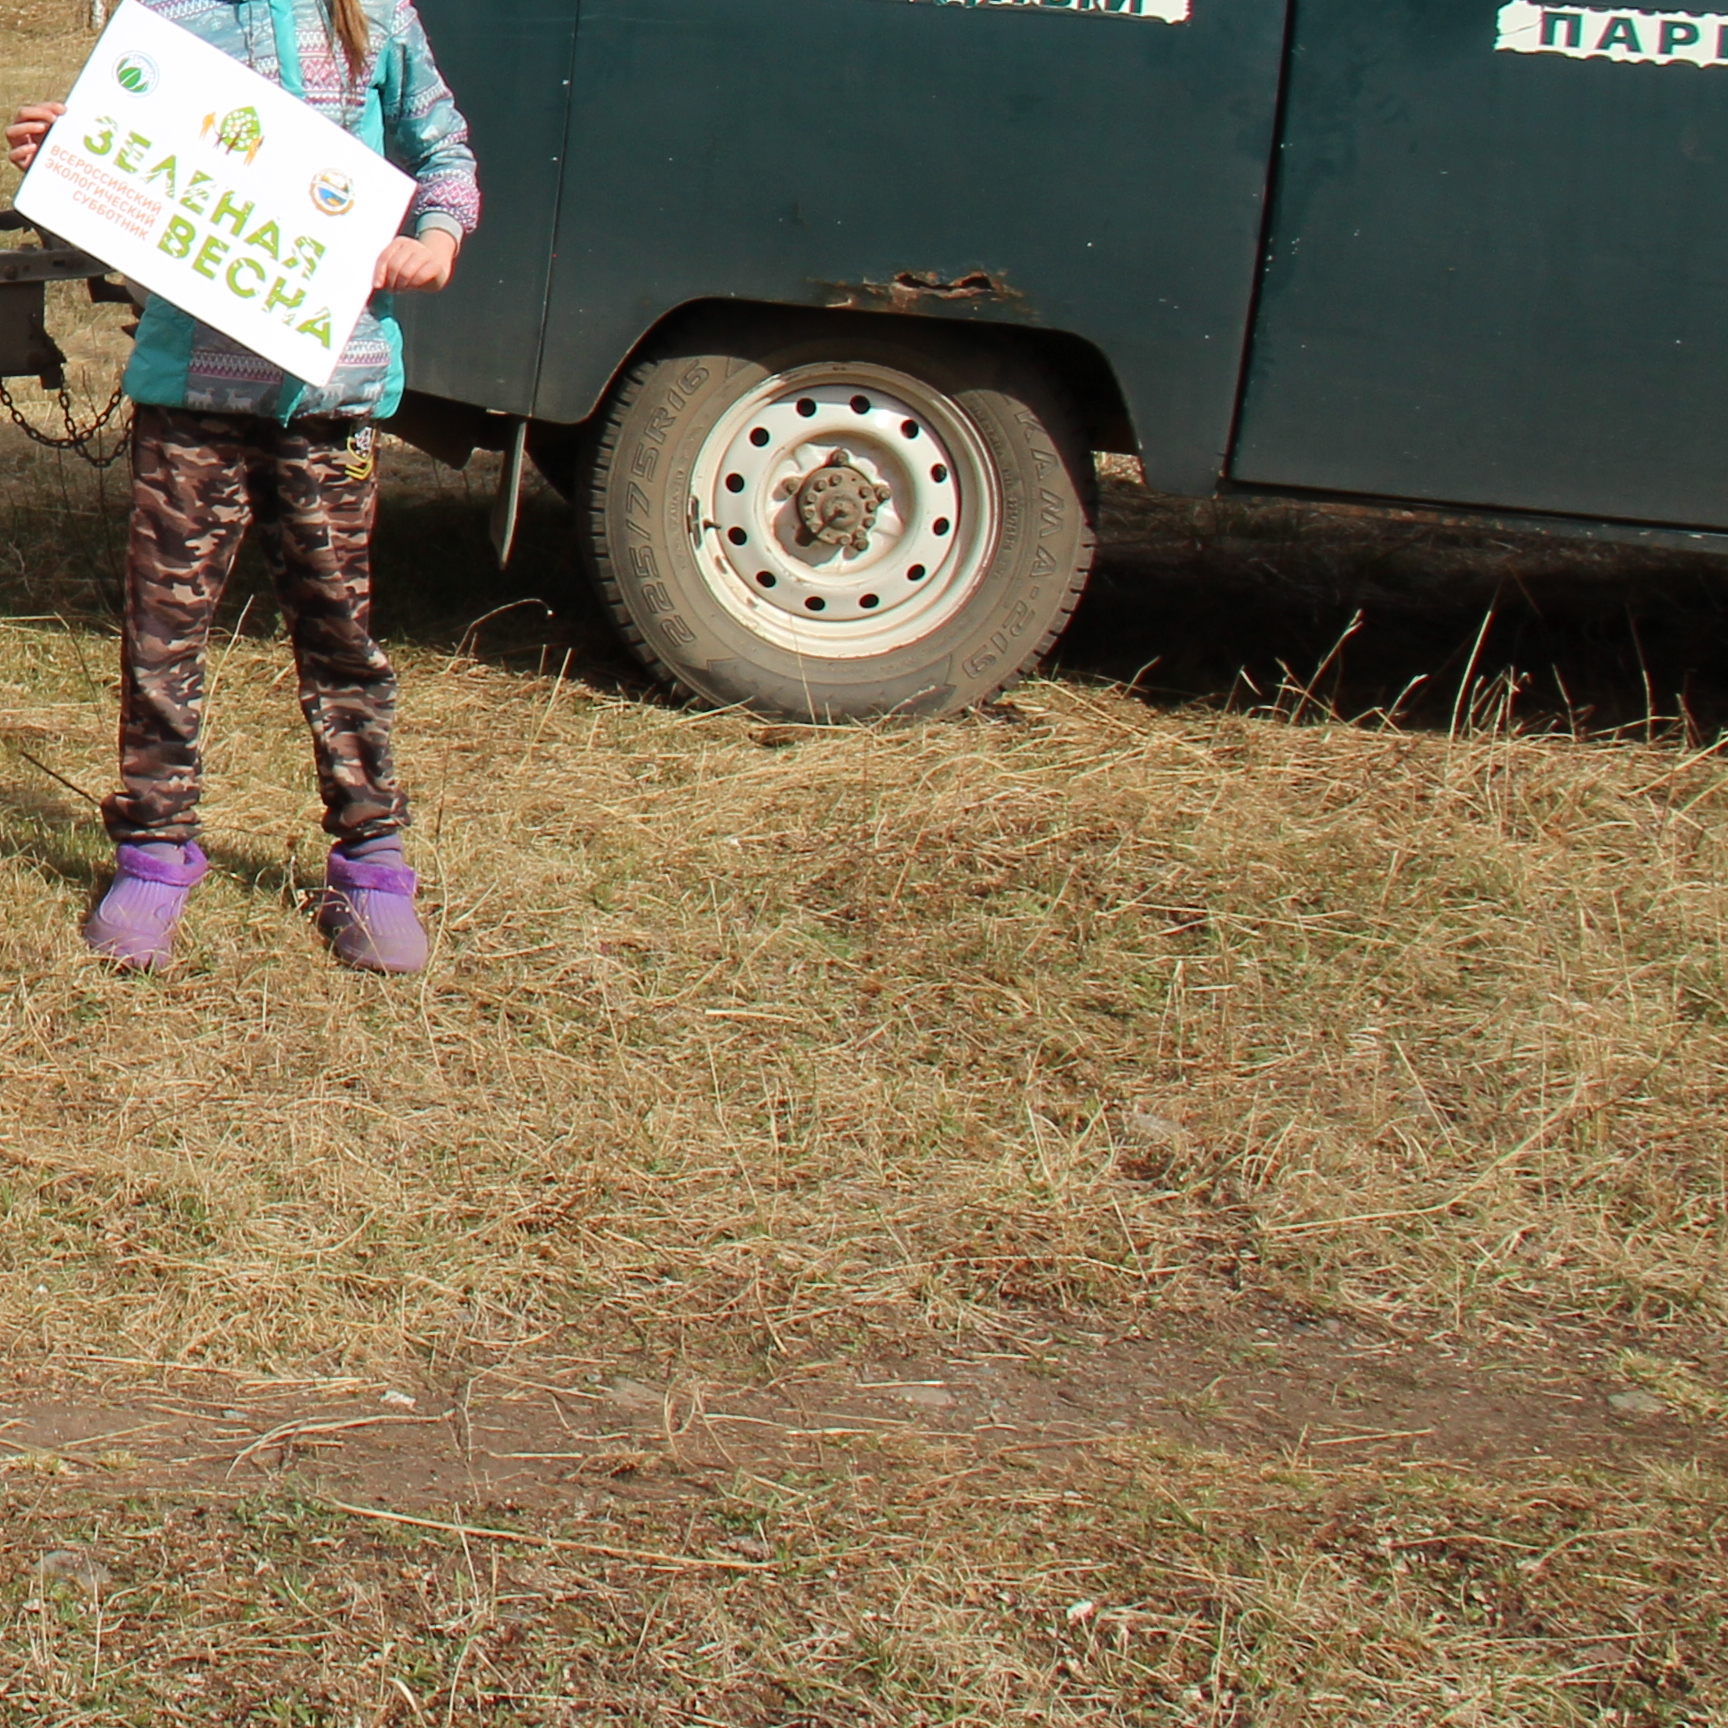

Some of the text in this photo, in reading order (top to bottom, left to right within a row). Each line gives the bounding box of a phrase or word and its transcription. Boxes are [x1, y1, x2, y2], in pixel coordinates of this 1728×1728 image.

[44, 157, 156, 228] ЭКОЛОГИЧЕСКИЙ
[49, 144, 163, 216] ВСЕРОССИЙСКИЙ
[72, 189, 150, 241] СУББОТНИК
[157, 214, 332, 349] ВЕСНА
[625, 359, 711, 650] 225/75R16
